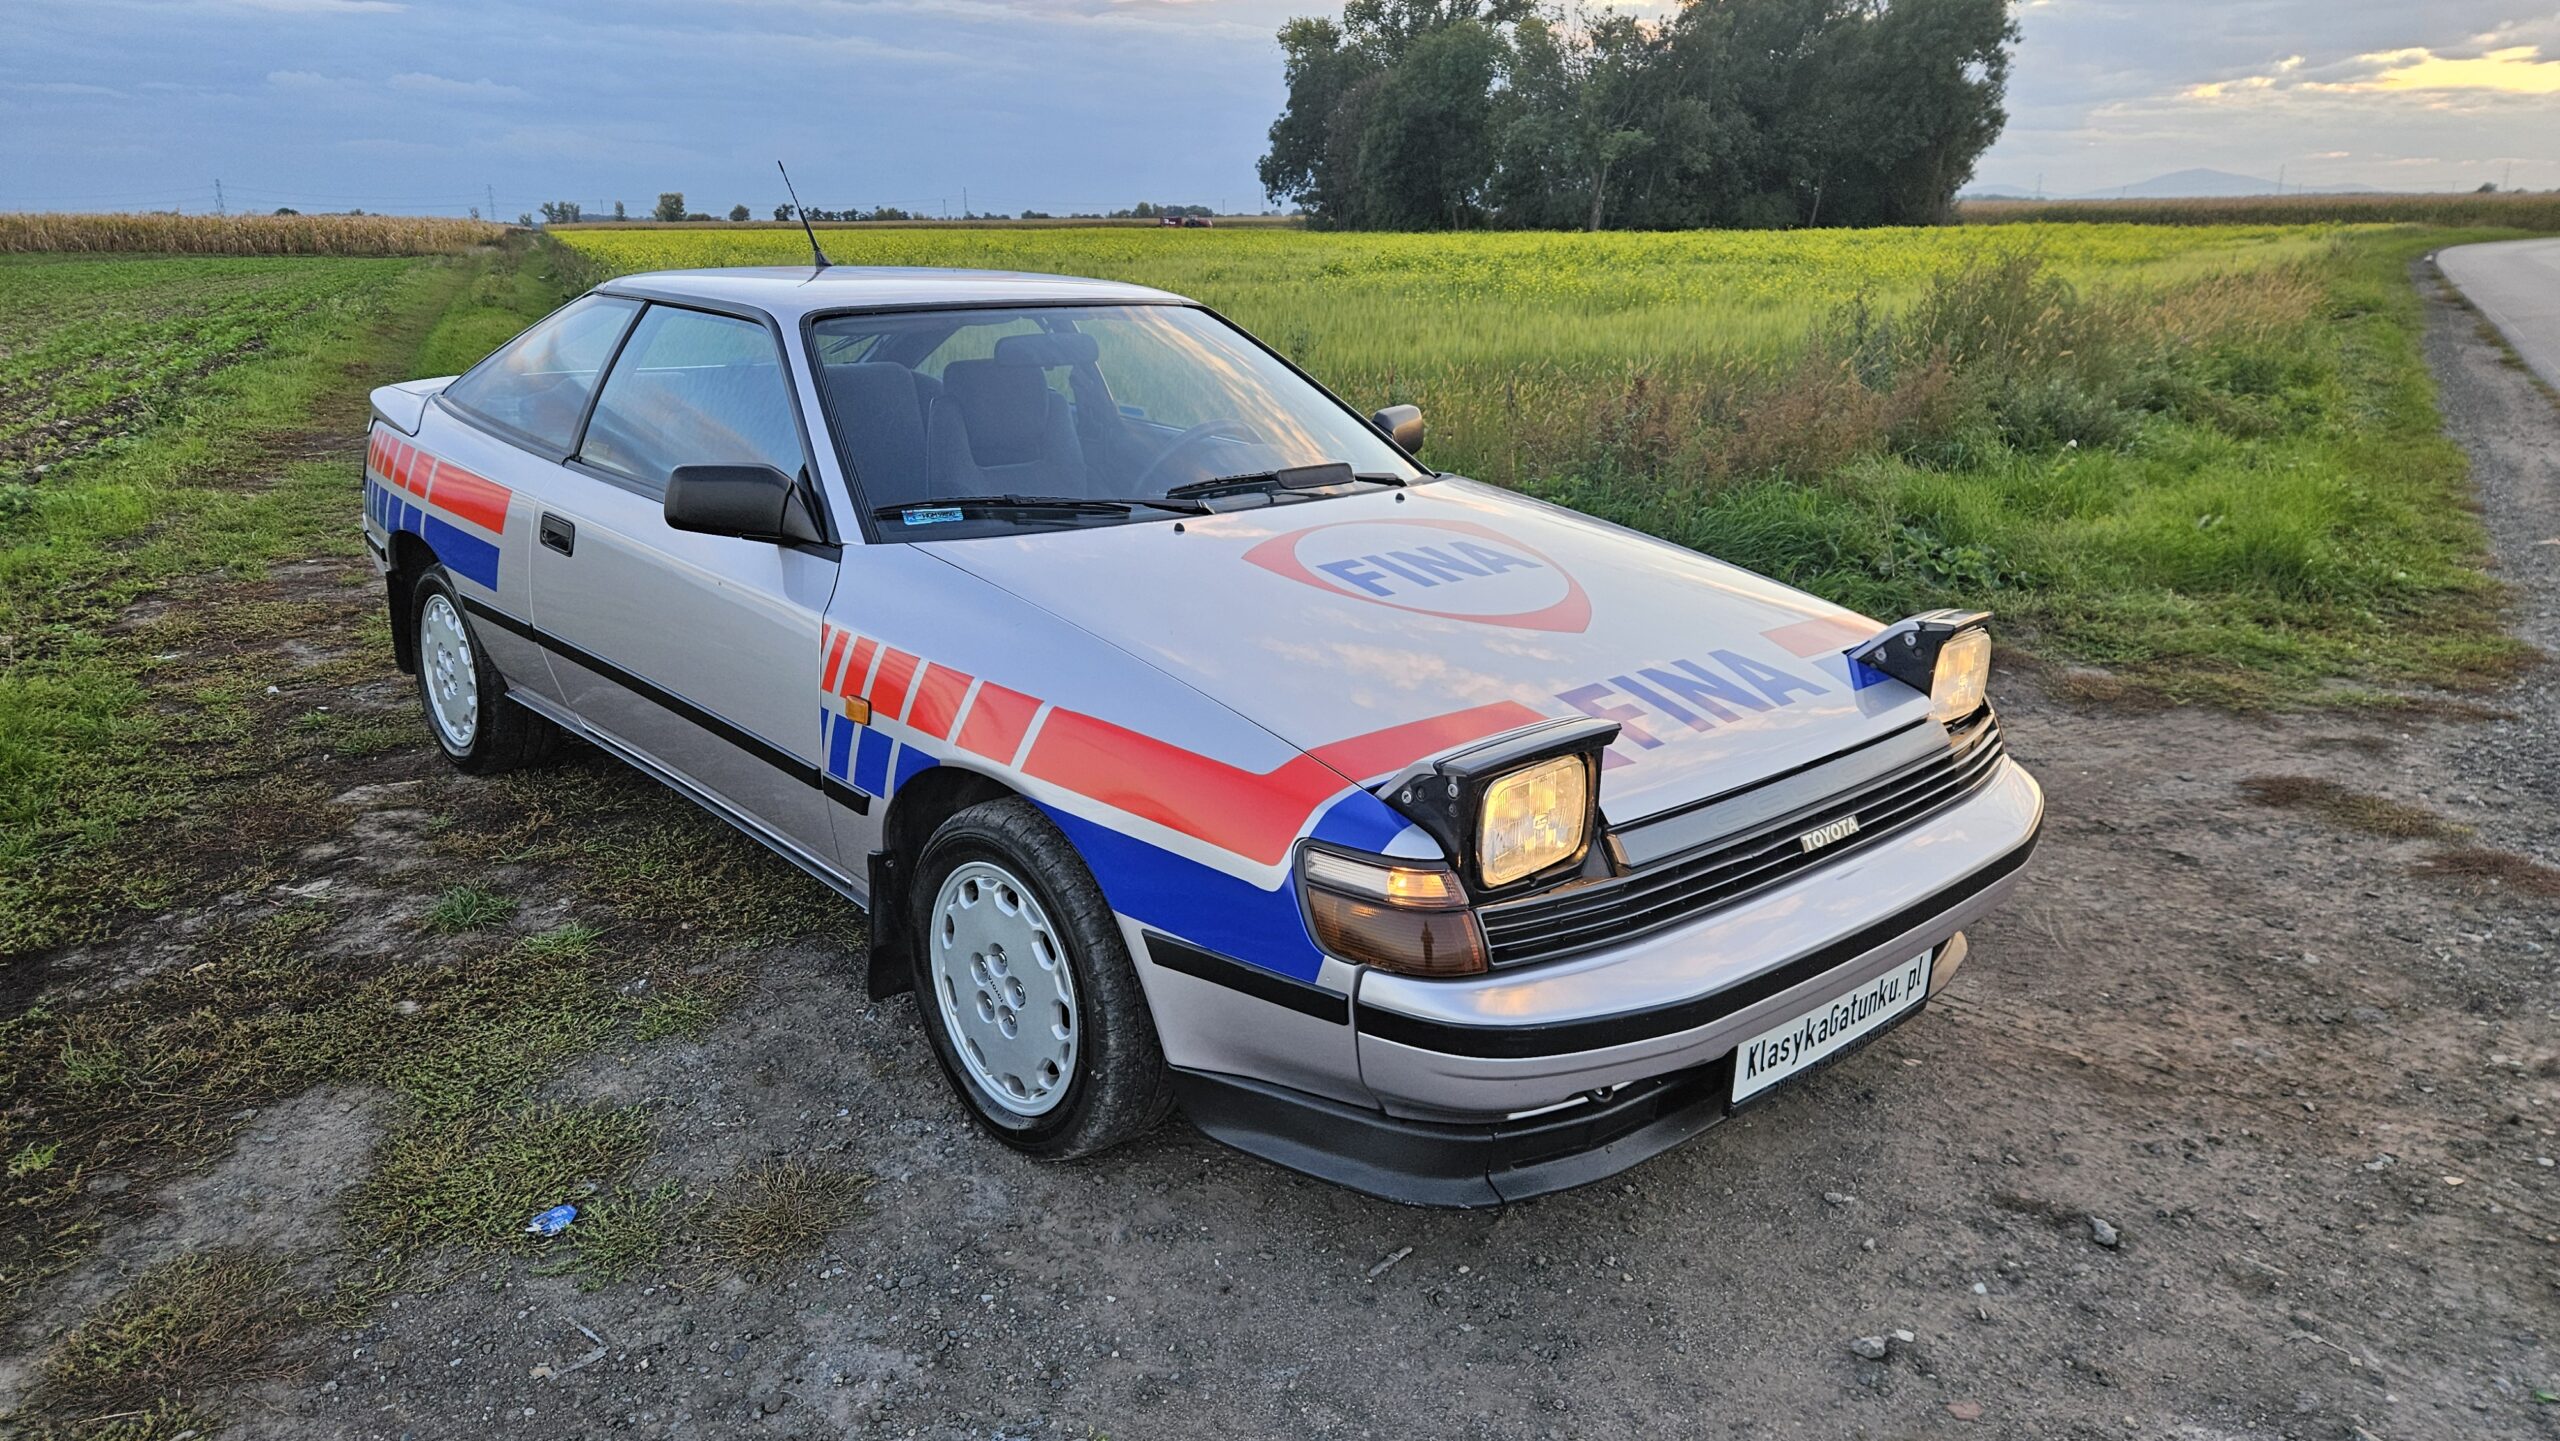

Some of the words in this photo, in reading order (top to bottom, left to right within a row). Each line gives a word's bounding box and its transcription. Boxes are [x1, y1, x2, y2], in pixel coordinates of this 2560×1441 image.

[1316, 541, 1544, 597] FINA
[1555, 649, 1831, 750] FINA
[1802, 815, 1860, 851] TOYOTA
